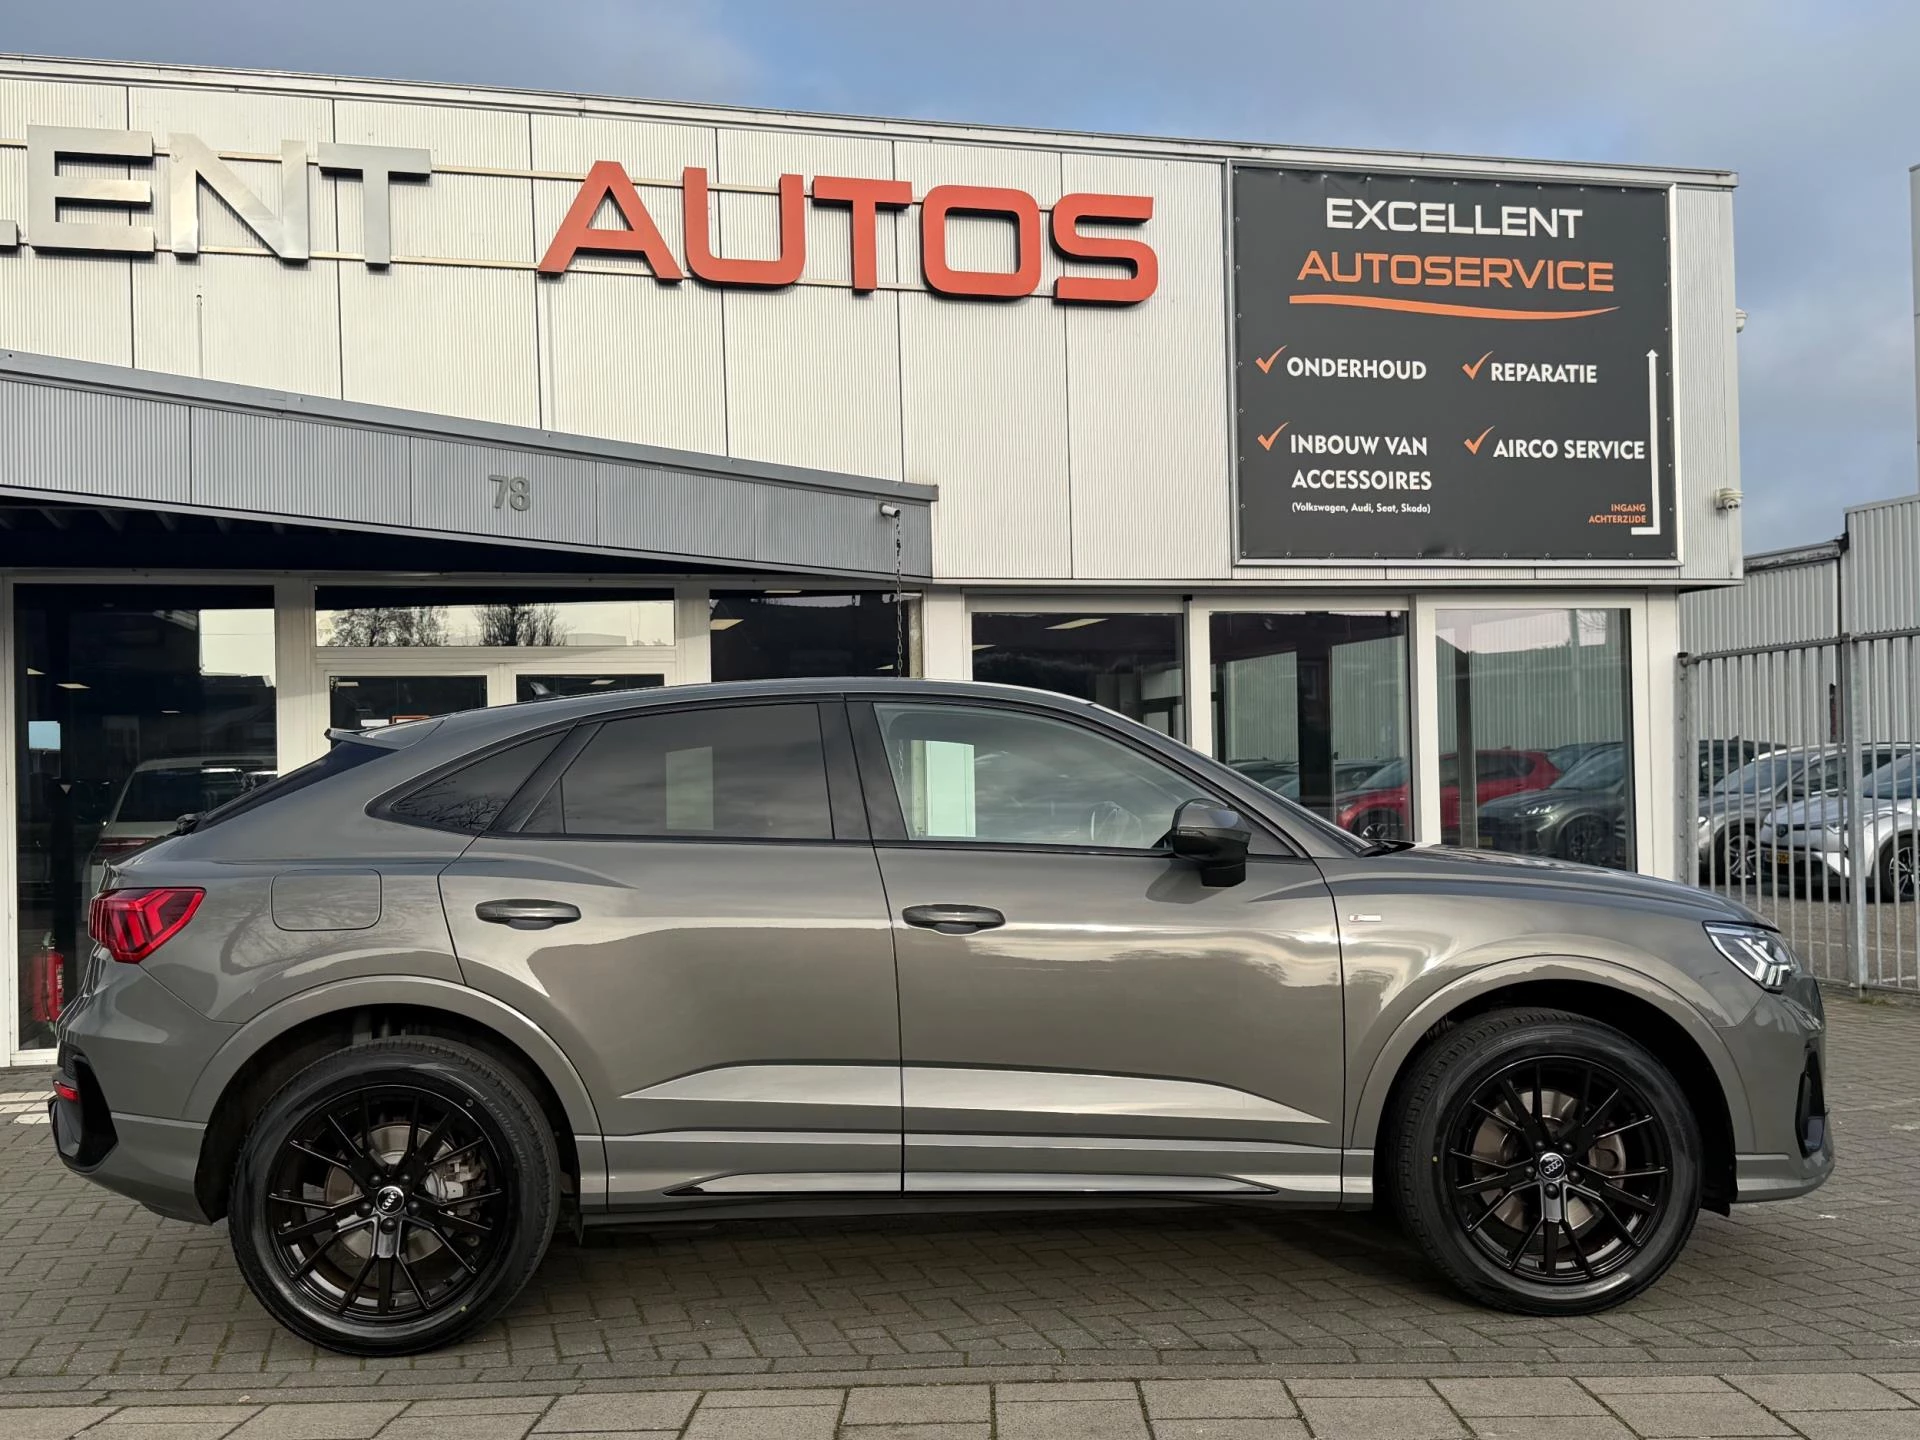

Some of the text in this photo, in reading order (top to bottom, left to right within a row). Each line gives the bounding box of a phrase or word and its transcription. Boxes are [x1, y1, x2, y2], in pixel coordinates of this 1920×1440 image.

[0, 125, 1159, 305] ENT AUTOS
[1325, 197, 1584, 239] EXCELLENT
[1297, 250, 1615, 293] AUTOSERVICE
[1286, 357, 1428, 380] ONDERHOUD
[1490, 363, 1598, 384] REPARATIE
[1290, 435, 1428, 456] INBOUW VAN
[1493, 439, 1646, 461] AIRCO SERVICE
[1291, 469, 1433, 491] ACCESSOIRES
[488, 475, 530, 511] 78
[1291, 501, 1431, 514] (Volkswagen, Audi, Seat, Skoda)
[1611, 503, 1646, 512] INGANG
